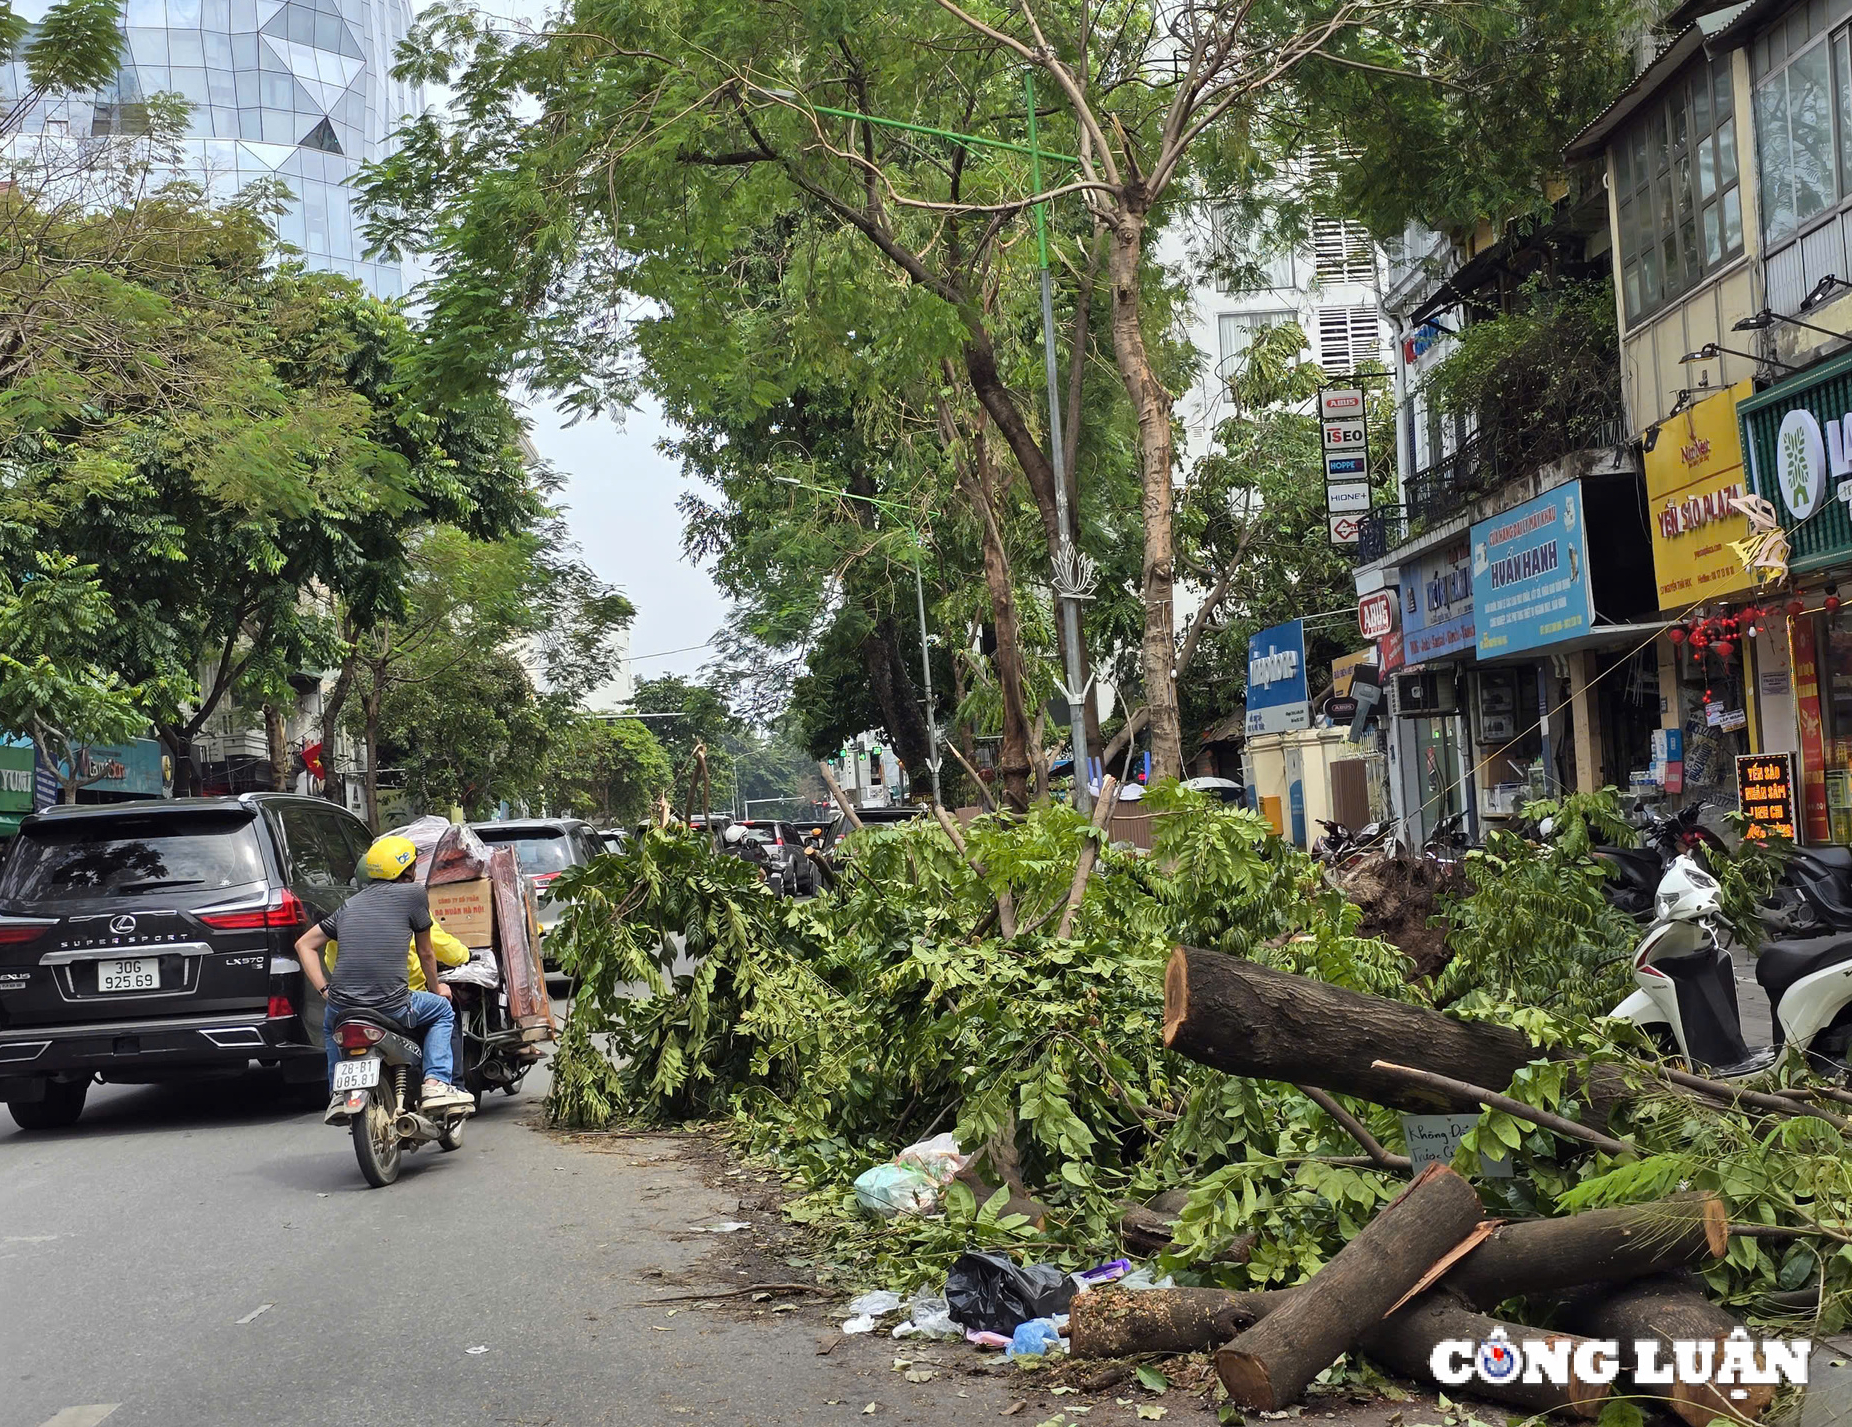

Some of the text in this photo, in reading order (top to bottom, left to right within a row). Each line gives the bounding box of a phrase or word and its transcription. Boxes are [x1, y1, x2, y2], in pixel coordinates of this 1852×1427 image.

[1330, 398, 1356, 407] ABUS
[1327, 427, 1363, 443] ISEO
[1330, 460, 1356, 470] HOPPE
[1657, 498, 1680, 538] YẾN
[1680, 495, 1701, 531] SÀO
[1521, 539, 1558, 582] HẠNH
[395, 852, 410, 865] be
[61, 934, 188, 948] SUPER SPORT
[116, 960, 142, 974] 30G
[225, 956, 264, 966] LX570
[105, 973, 153, 989] 925.69
[341, 1060, 372, 1076] 28-B1
[336, 1073, 375, 1089] 085.81
